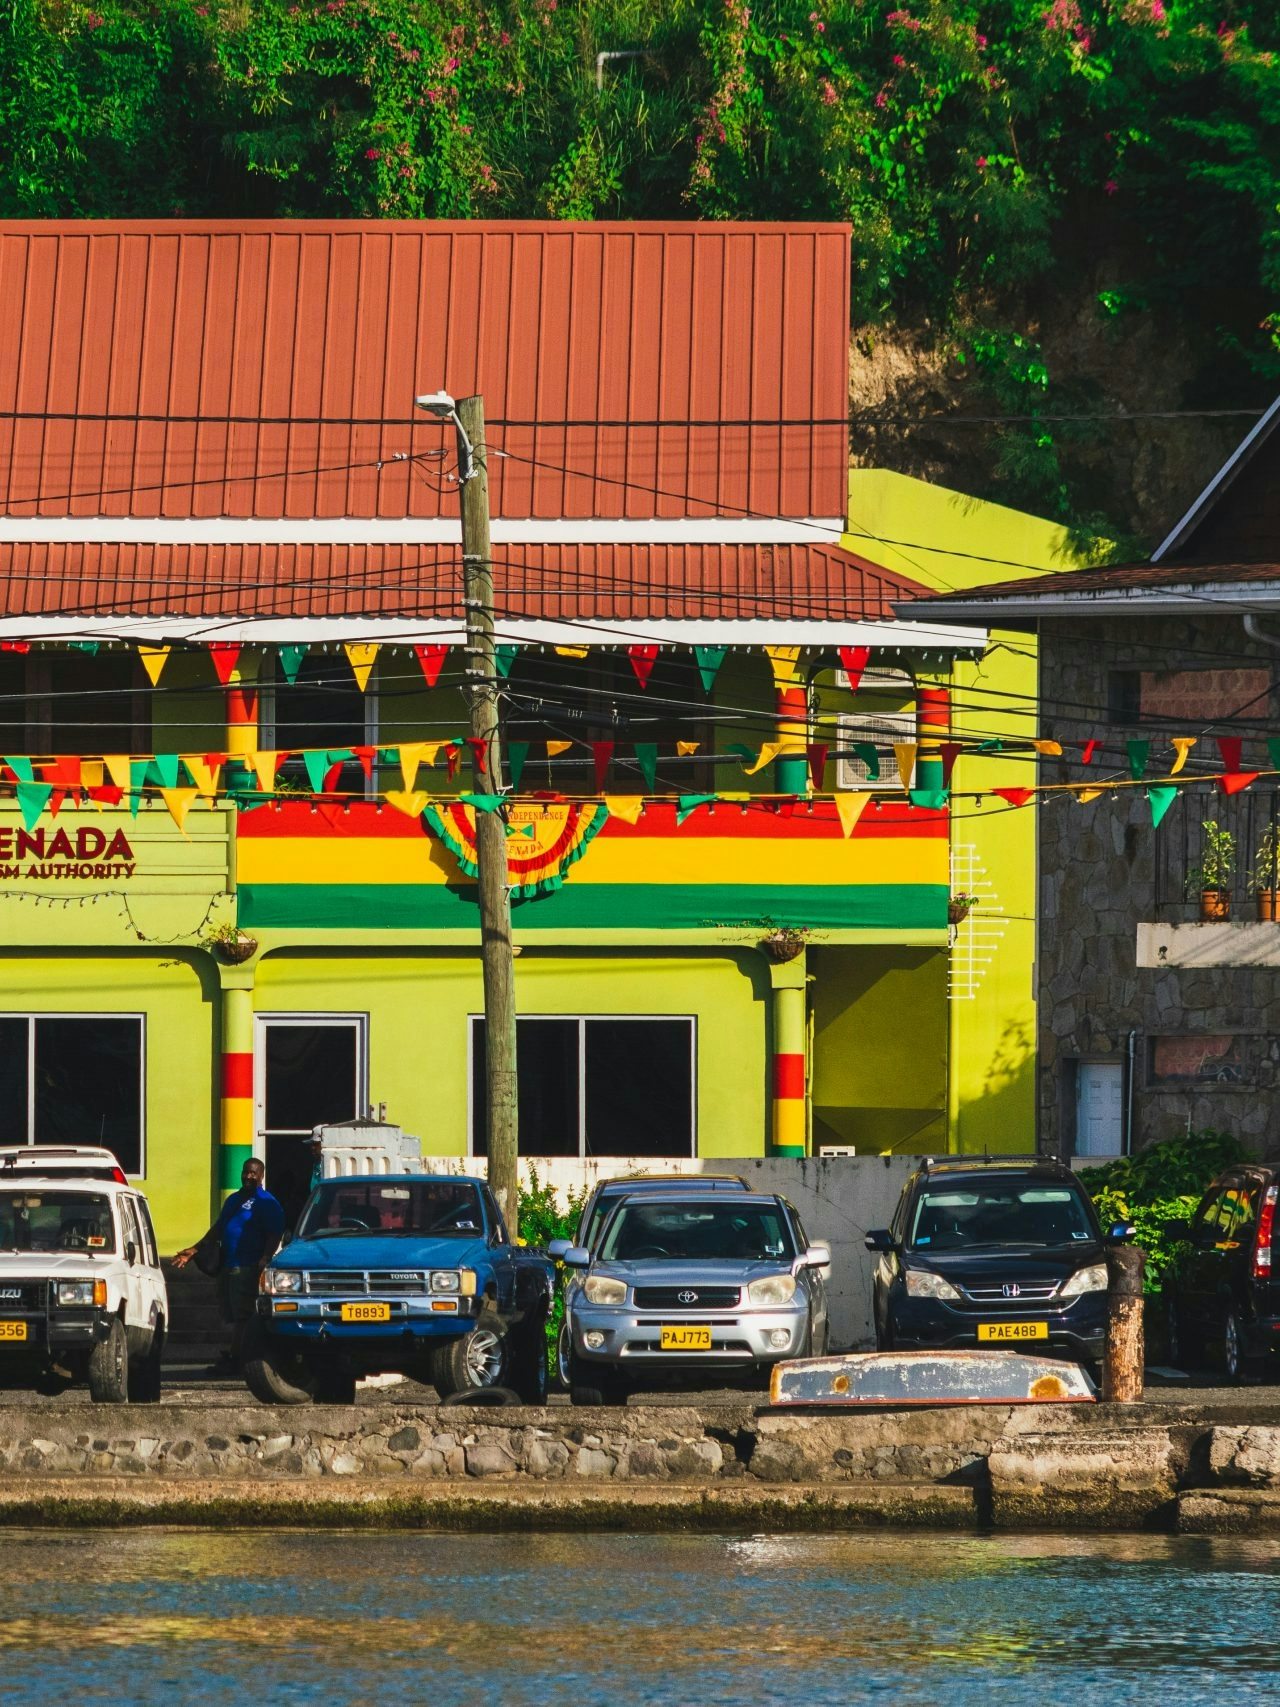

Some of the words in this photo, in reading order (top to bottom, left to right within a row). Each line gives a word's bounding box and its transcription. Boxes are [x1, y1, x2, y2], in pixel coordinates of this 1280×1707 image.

[25, 862, 137, 880] AUTHORITY
[347, 1307, 385, 1318] T8893
[662, 1331, 710, 1344] PAJ773
[988, 1325, 1037, 1338] PAE488
